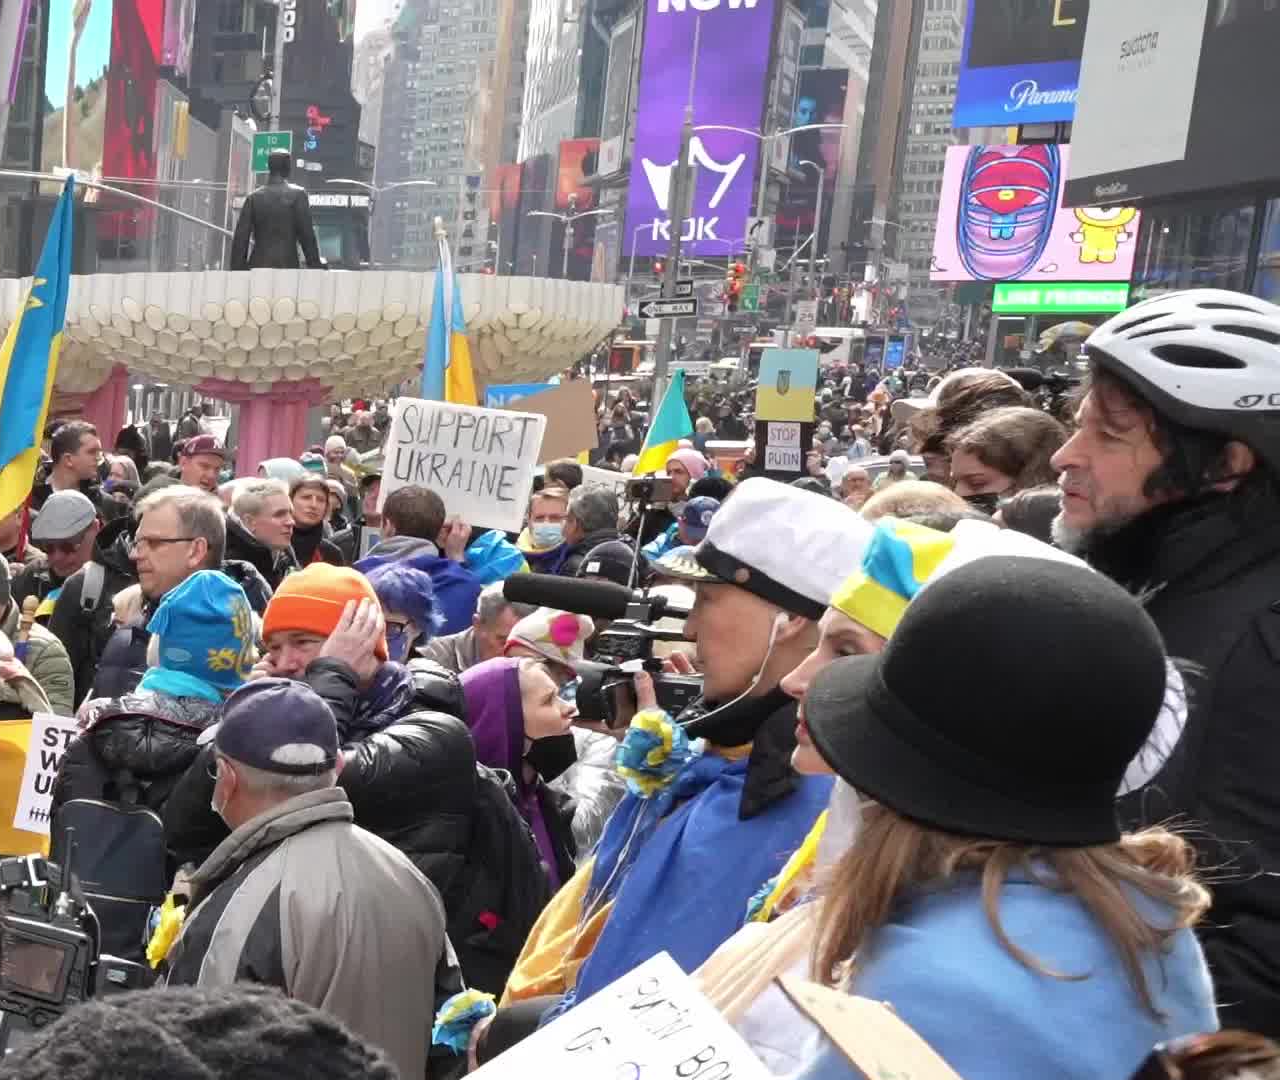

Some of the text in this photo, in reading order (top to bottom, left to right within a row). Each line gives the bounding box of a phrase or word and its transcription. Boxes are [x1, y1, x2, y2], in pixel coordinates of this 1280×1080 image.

[1004, 79, 1080, 113] Paramo
[397, 404, 538, 460] SUPPORT
[769, 427, 796, 441] STOP
[394, 447, 518, 502] UKRAINE
[768, 452, 799, 465] PUTIN
